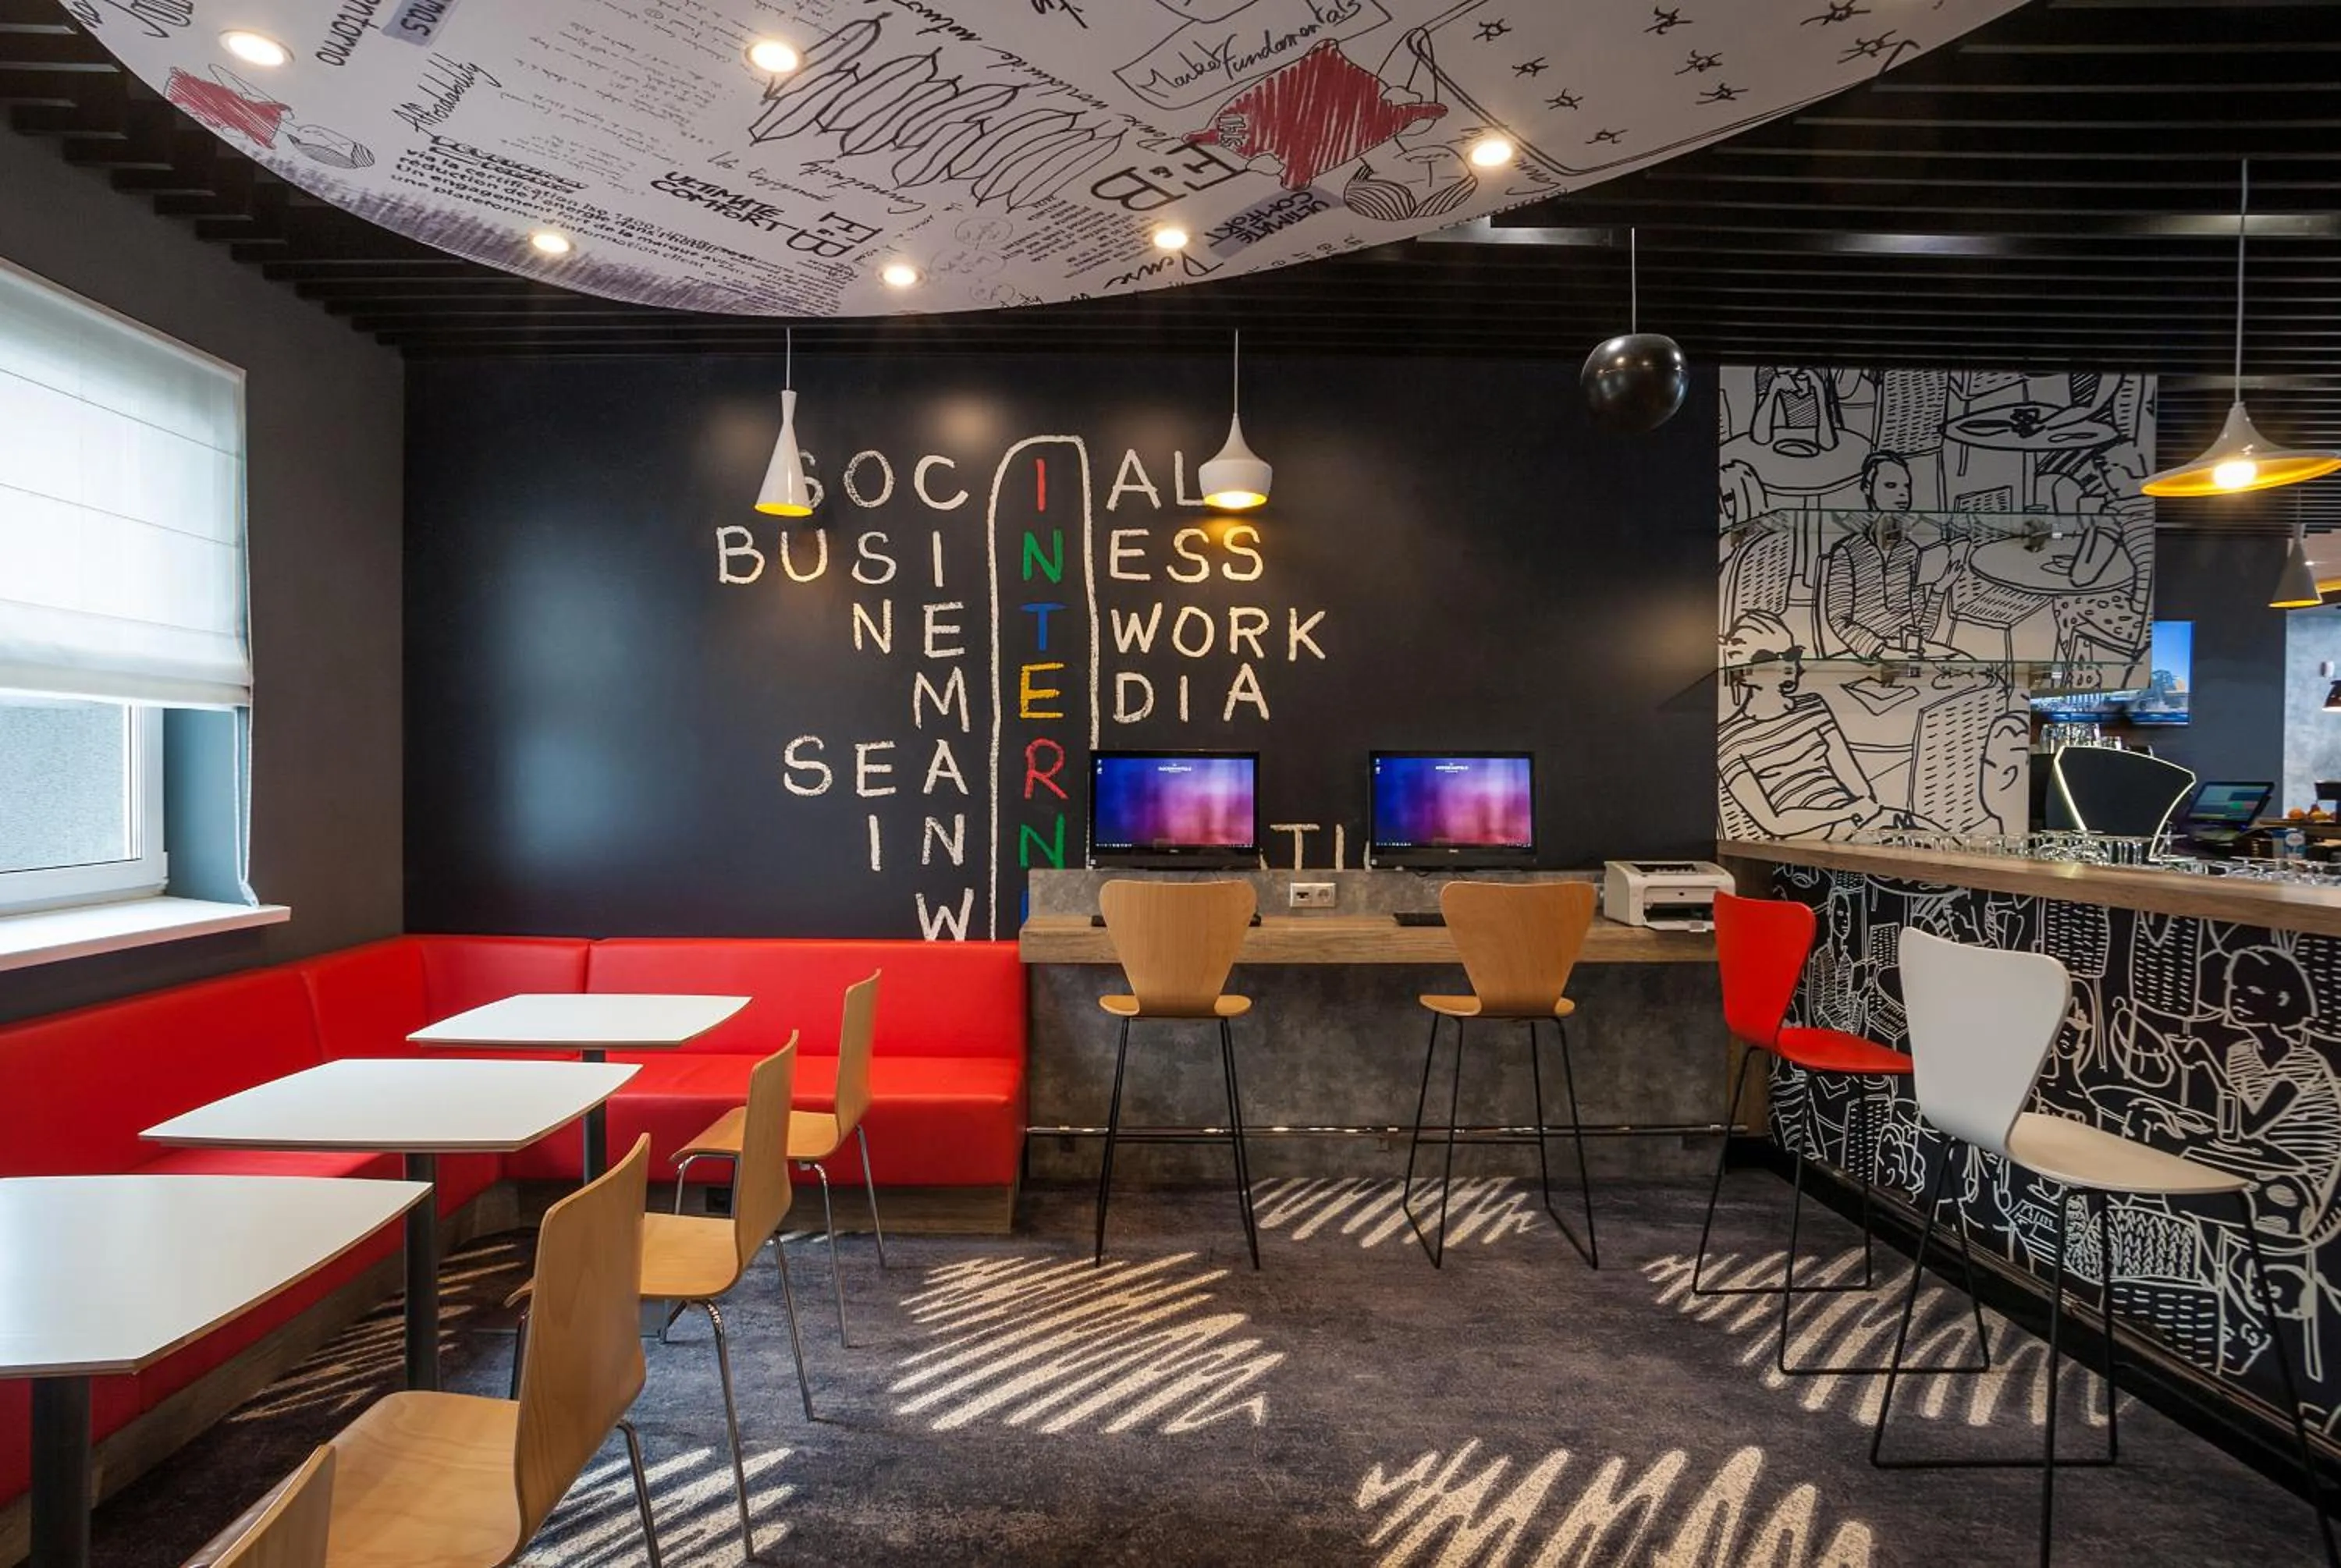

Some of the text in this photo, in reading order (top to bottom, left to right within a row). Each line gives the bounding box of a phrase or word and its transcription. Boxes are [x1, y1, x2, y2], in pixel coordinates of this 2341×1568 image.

[1137, 41, 1224, 97] Market
[650, 179, 799, 232] COMFORT
[665, 171, 784, 217] ULTIMATE
[1204, 192, 1314, 247] COMFORT
[1235, 200, 1330, 243] ULTIMATE
